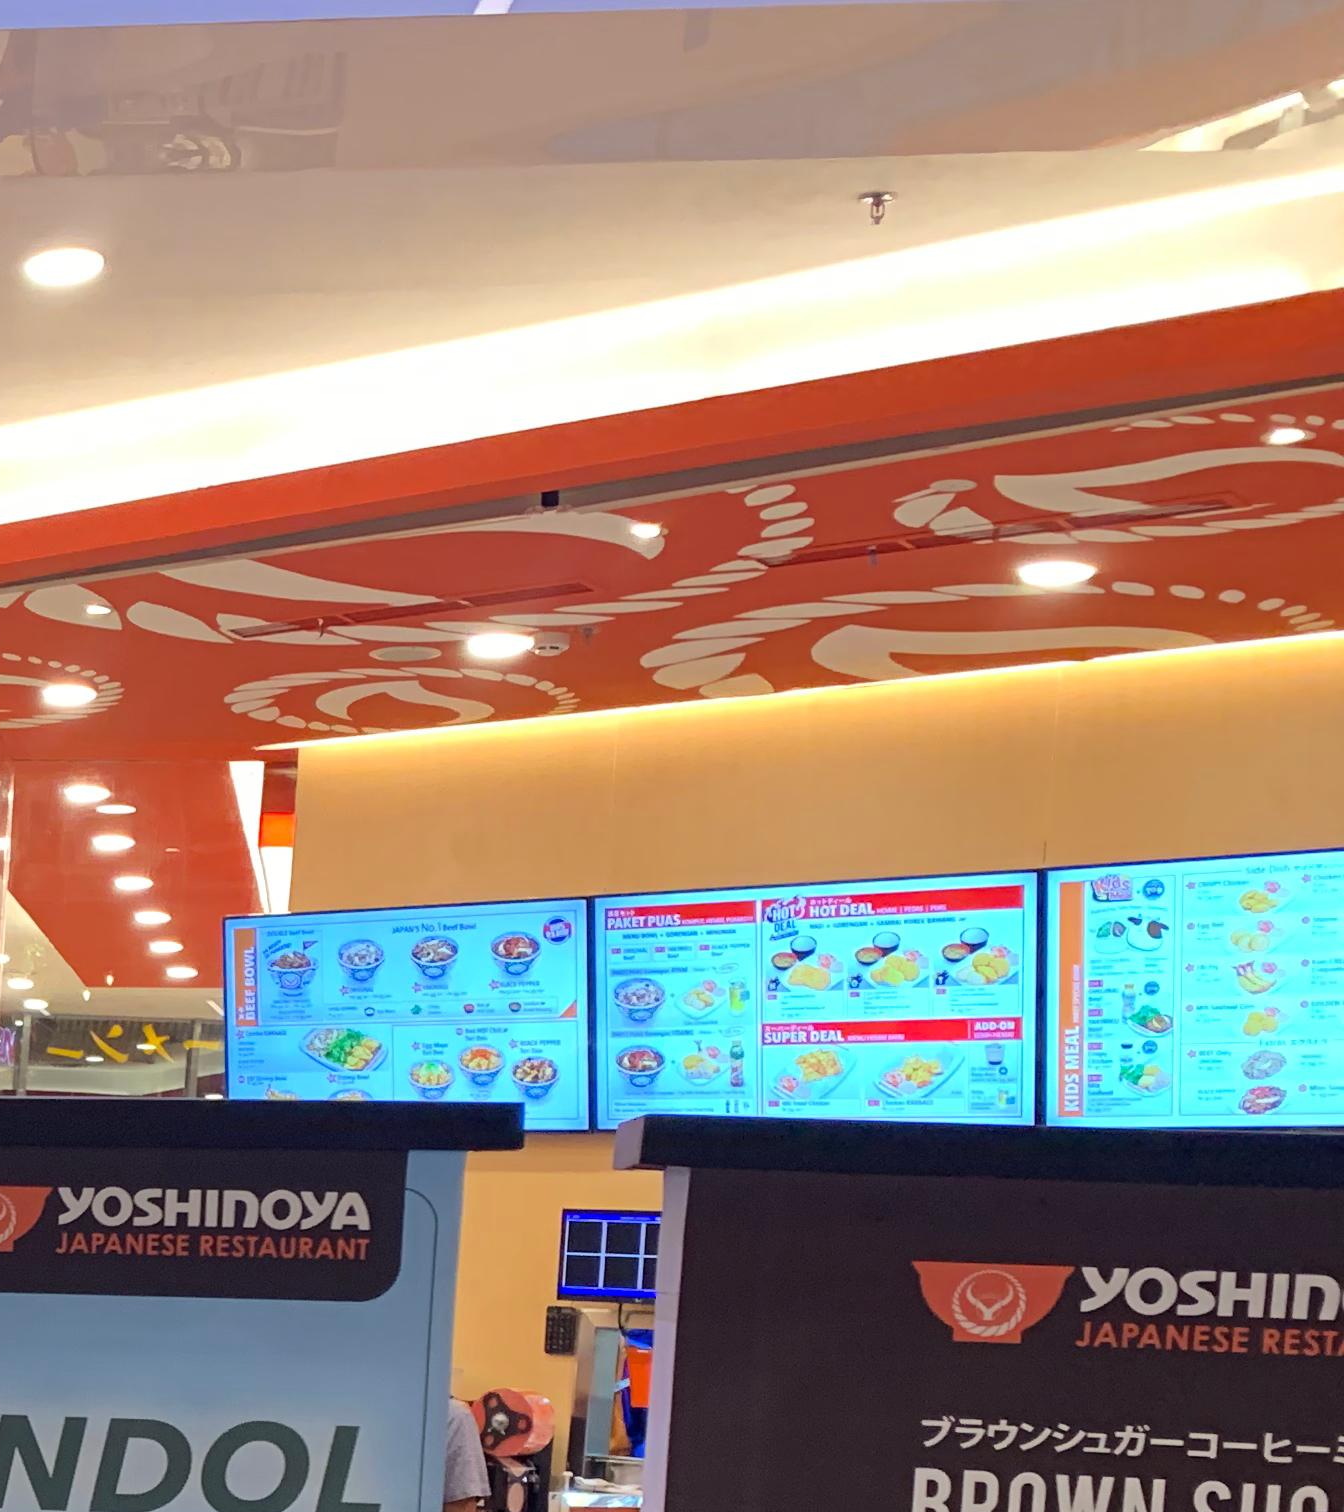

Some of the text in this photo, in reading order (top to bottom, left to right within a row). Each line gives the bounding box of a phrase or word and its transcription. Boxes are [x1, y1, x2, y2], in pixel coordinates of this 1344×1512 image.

[607, 915, 645, 929] PAKET
[647, 914, 681, 927] PUAS
[809, 905, 836, 918] HOT
[842, 903, 875, 916] DEAL
[763, 1030, 808, 1044] SUPER
[810, 1029, 845, 1043] DEAL
[1064, 1025, 1080, 1070] MEAL
[1064, 1073, 1080, 1112] KIDS
[56, 1186, 371, 1231] YOSHINOYA
[55, 1230, 371, 1262] JAPANESE RESTAURANT
